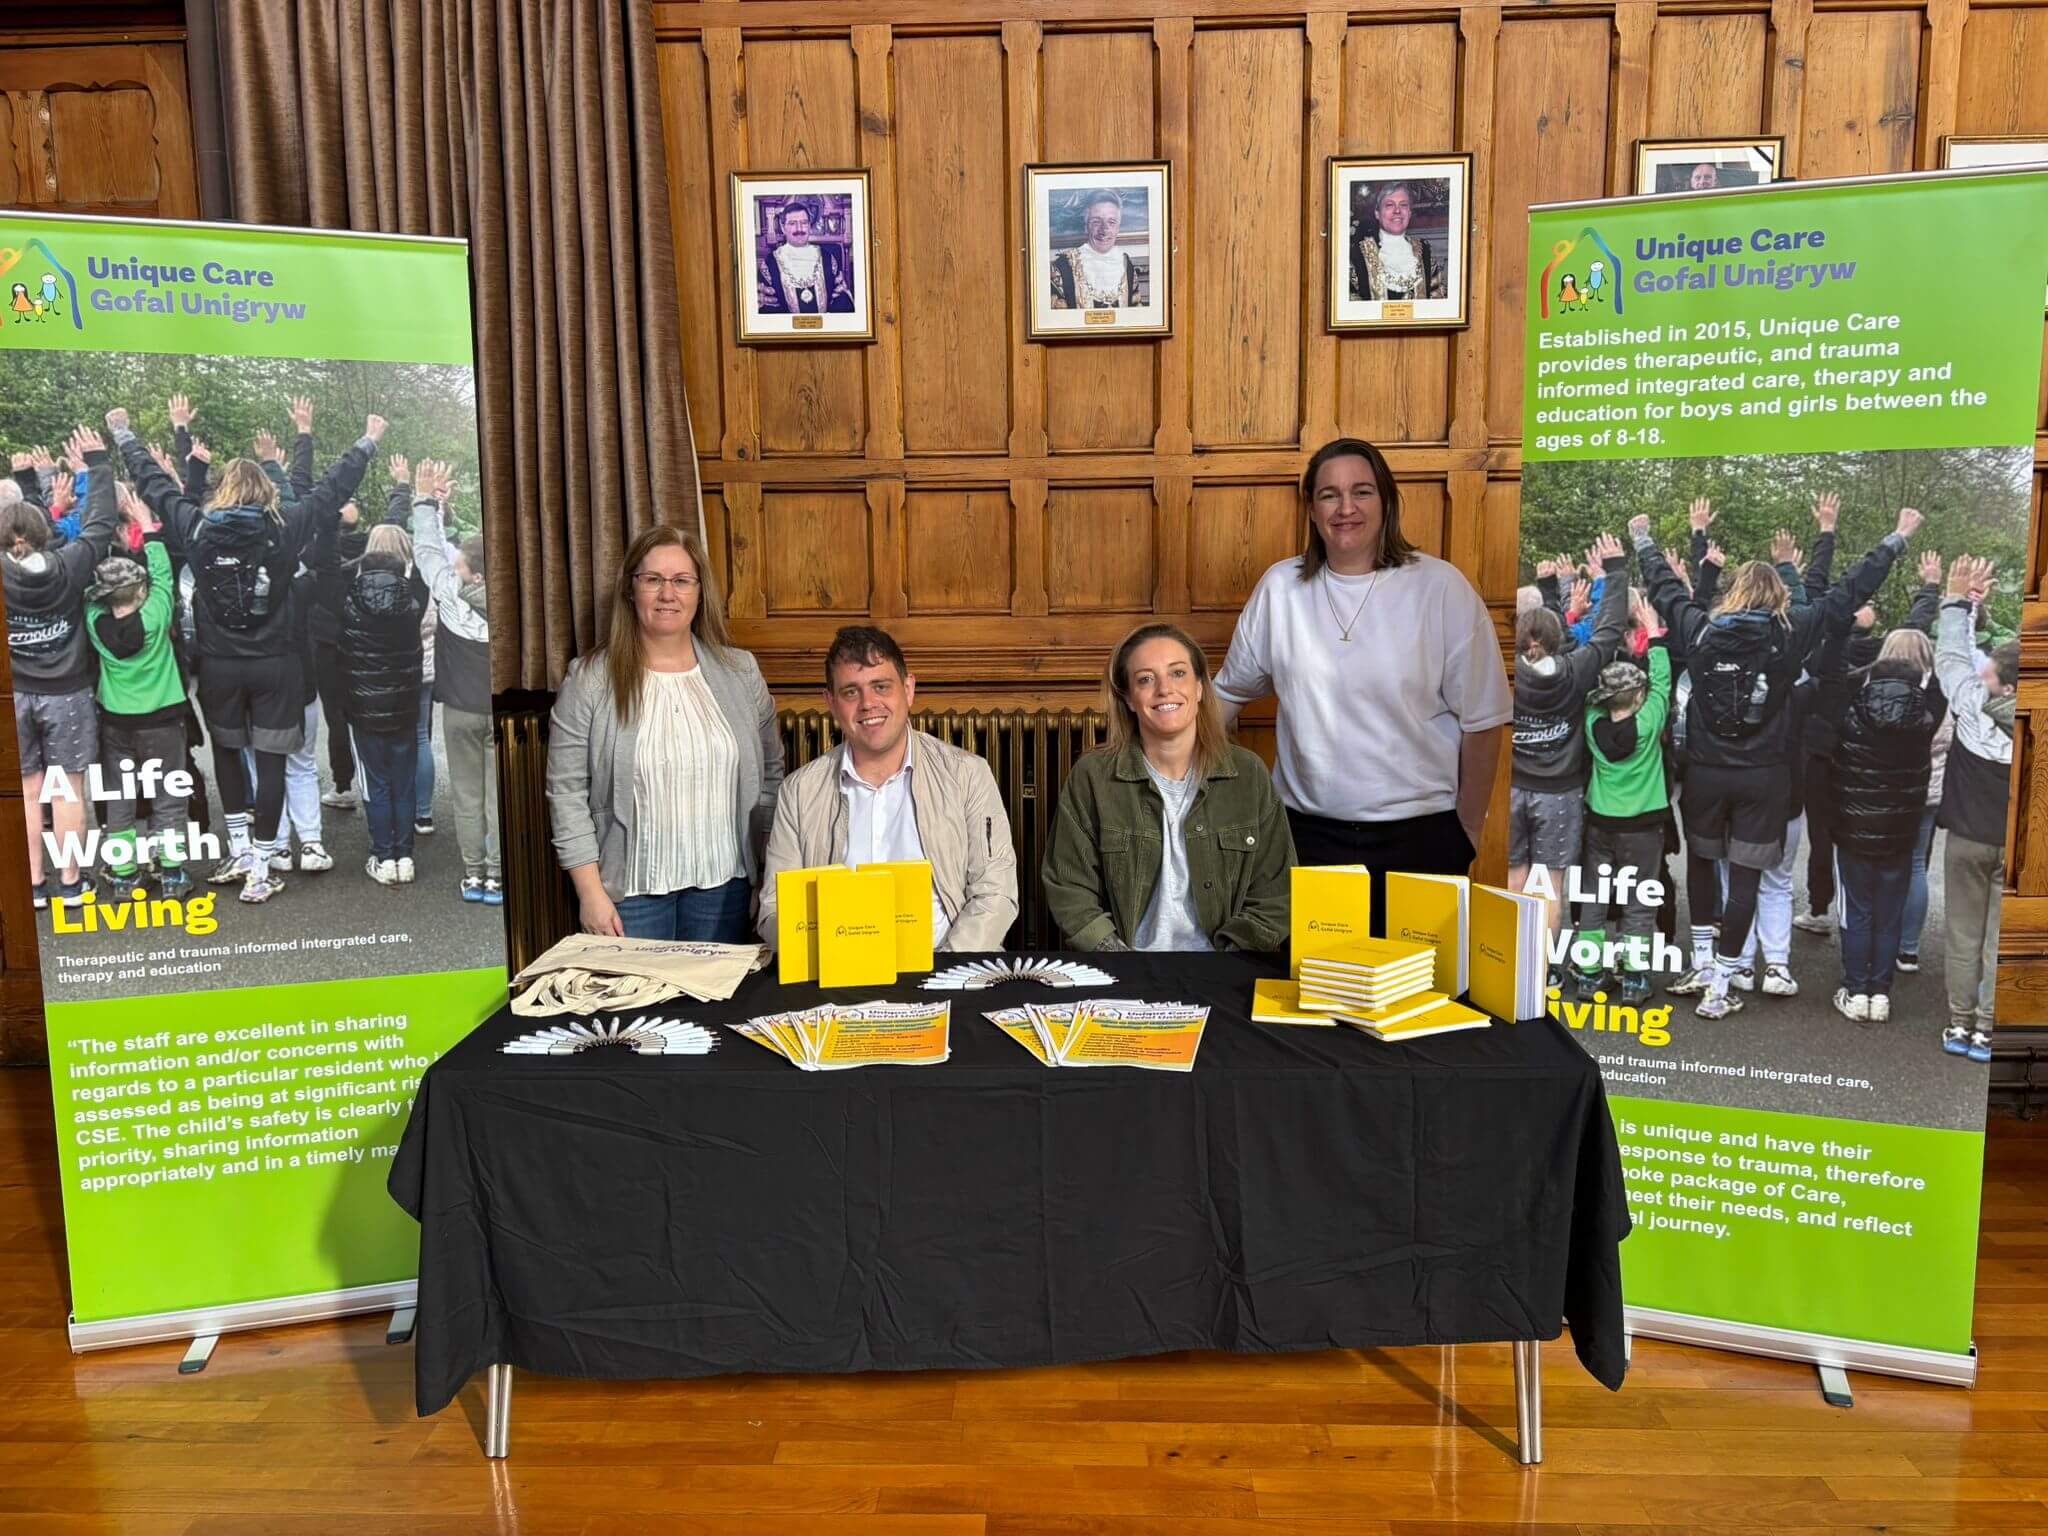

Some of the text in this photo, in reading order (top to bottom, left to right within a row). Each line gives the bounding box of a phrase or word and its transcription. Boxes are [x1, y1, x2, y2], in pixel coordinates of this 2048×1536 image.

[1635, 228, 1825, 262] Unique Care
[88, 257, 273, 288] Unique Care
[1634, 258, 1856, 293] Gofal Unigryw
[91, 289, 305, 323] Gofal Unigryw
[1539, 312, 1900, 350] Established in 2015, Unique Care
[1539, 339, 1899, 377] provides therapeutic, and trauma
[1538, 362, 1952, 399] informed integrated care, therapy and
[1536, 388, 1987, 424] education for boys and girls between the
[1536, 427, 1665, 451] ages of 8-18.
[38, 759, 194, 804] A Life
[41, 822, 220, 869] Worth
[1522, 864, 1665, 907] A Life
[51, 888, 218, 935] Living
[56, 932, 412, 968] Therapeutic and trauma informed intergrated care,
[58, 960, 221, 985] therapy and education
[68, 1012, 407, 1055] “The staff are excellent in sharing
[1546, 989, 1674, 1047] iving
[70, 1034, 404, 1078] information and/or concerns with
[1598, 1055, 1873, 1091] and trauma informed intergrated care,
[72, 1082, 151, 1102] regards
[158, 1077, 178, 1093] to
[185, 1078, 196, 1091] a
[203, 1069, 298, 1091] particular
[304, 1059, 383, 1079] resident
[389, 1053, 428, 1070] who
[74, 1103, 171, 1123] assessed
[178, 1099, 201, 1113] as
[208, 1091, 264, 1112] being
[270, 1089, 288, 1104] at
[294, 1078, 396, 1102] significant
[76, 1128, 126, 1146] CSE.
[132, 1123, 171, 1141] The
[249, 1108, 309, 1129] safety
[316, 1106, 332, 1121] is
[338, 1098, 401, 1119] clearly
[1619, 1119, 1872, 1161] is unique and have their
[78, 1127, 359, 1171] priority, sharing information
[80, 1166, 215, 1191] appropriately
[222, 1157, 259, 1175] and
[266, 1155, 283, 1170] in
[289, 1156, 300, 1168] a
[306, 1145, 364, 1166] timely
[1619, 1144, 1925, 1191] esponse to trauma, therefore
[1671, 1172, 1757, 1196] package
[1764, 1181, 1785, 1199] of
[1791, 1184, 1846, 1207] Care,
[1624, 1190, 1912, 1237] eet their needs, and reflect
[1648, 1211, 1730, 1238] journey.
